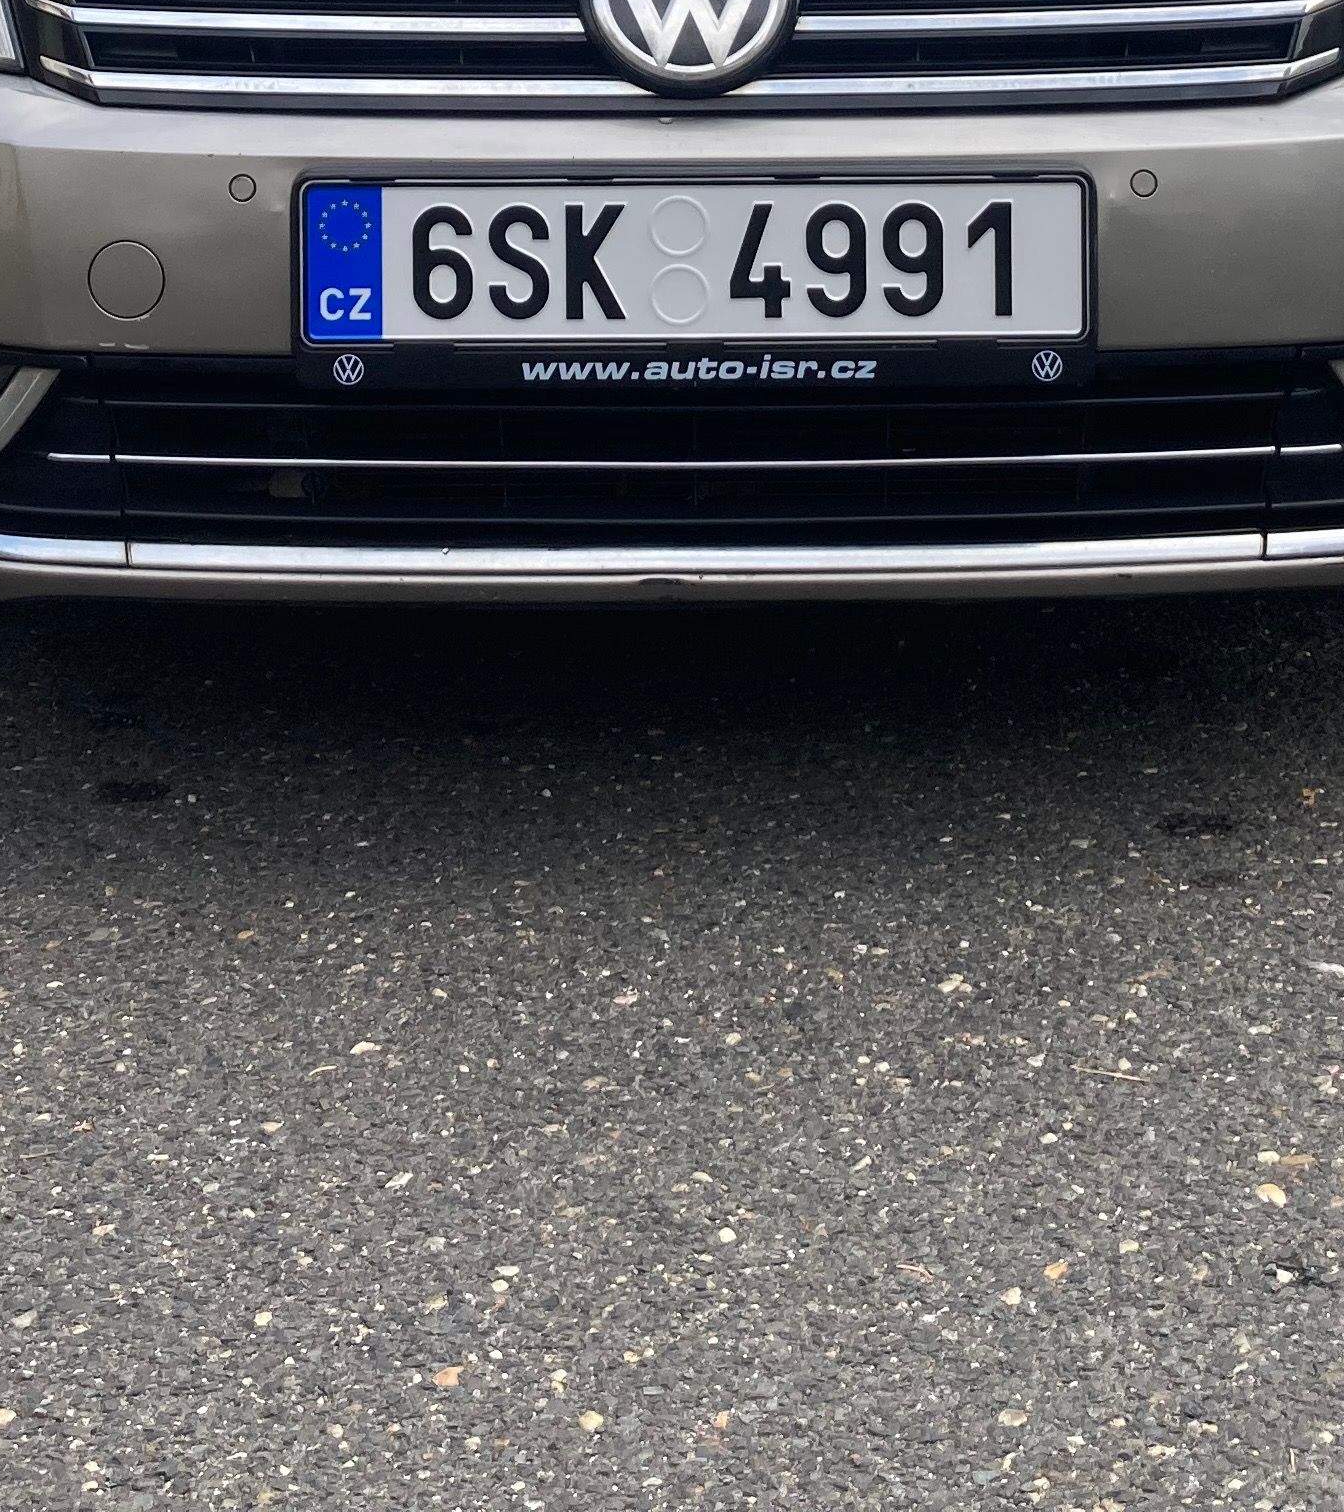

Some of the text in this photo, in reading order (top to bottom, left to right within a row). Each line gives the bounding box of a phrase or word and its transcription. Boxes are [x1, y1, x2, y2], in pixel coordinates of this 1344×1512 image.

[412, 201, 1013, 320] 6SK 4991
[320, 287, 372, 321] CZ
[521, 354, 877, 380] www.auto-isr.cz
